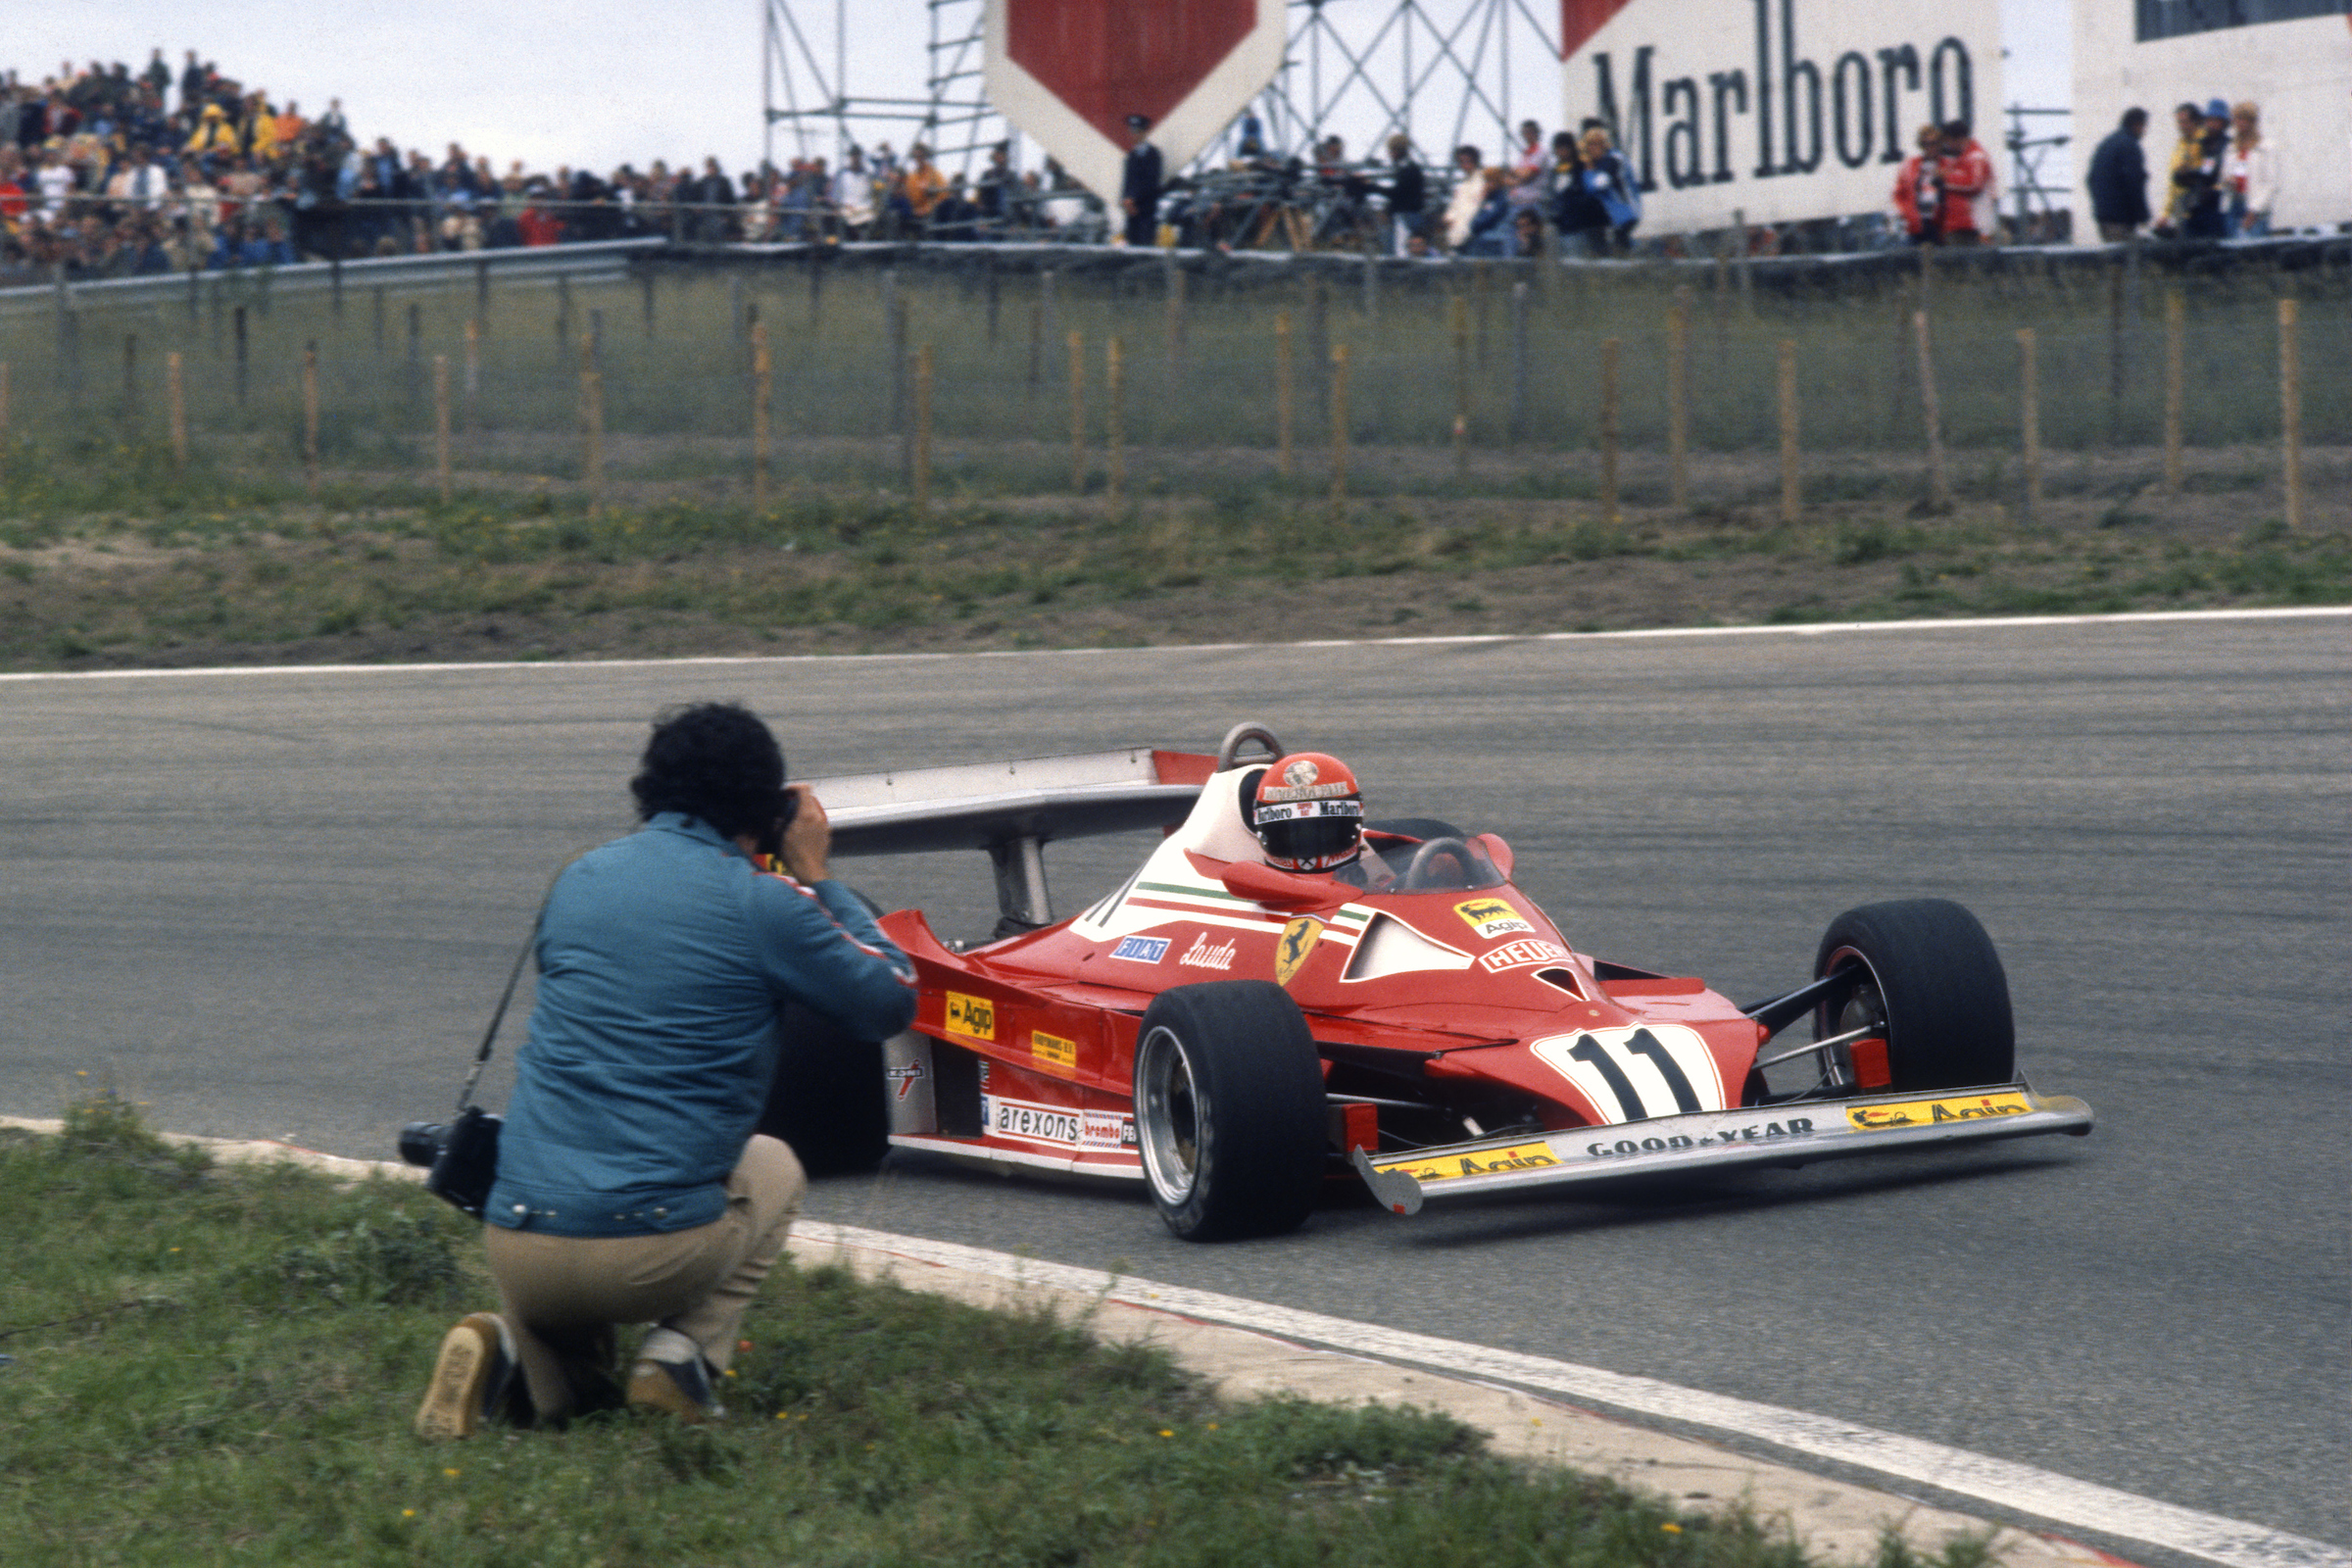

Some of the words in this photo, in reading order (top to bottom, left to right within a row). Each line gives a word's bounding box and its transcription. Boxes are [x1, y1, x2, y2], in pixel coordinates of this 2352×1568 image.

[1592, 0, 1973, 192] Marlboro
[1484, 919, 1529, 935] Agip
[1116, 939, 1166, 961] FIAT
[1179, 931, 1237, 971] Lauda
[962, 998, 993, 1037] Agip
[1566, 1027, 1703, 1123] 11
[1000, 1106, 1078, 1142] arexons
[1084, 1120, 1120, 1141] brembo
